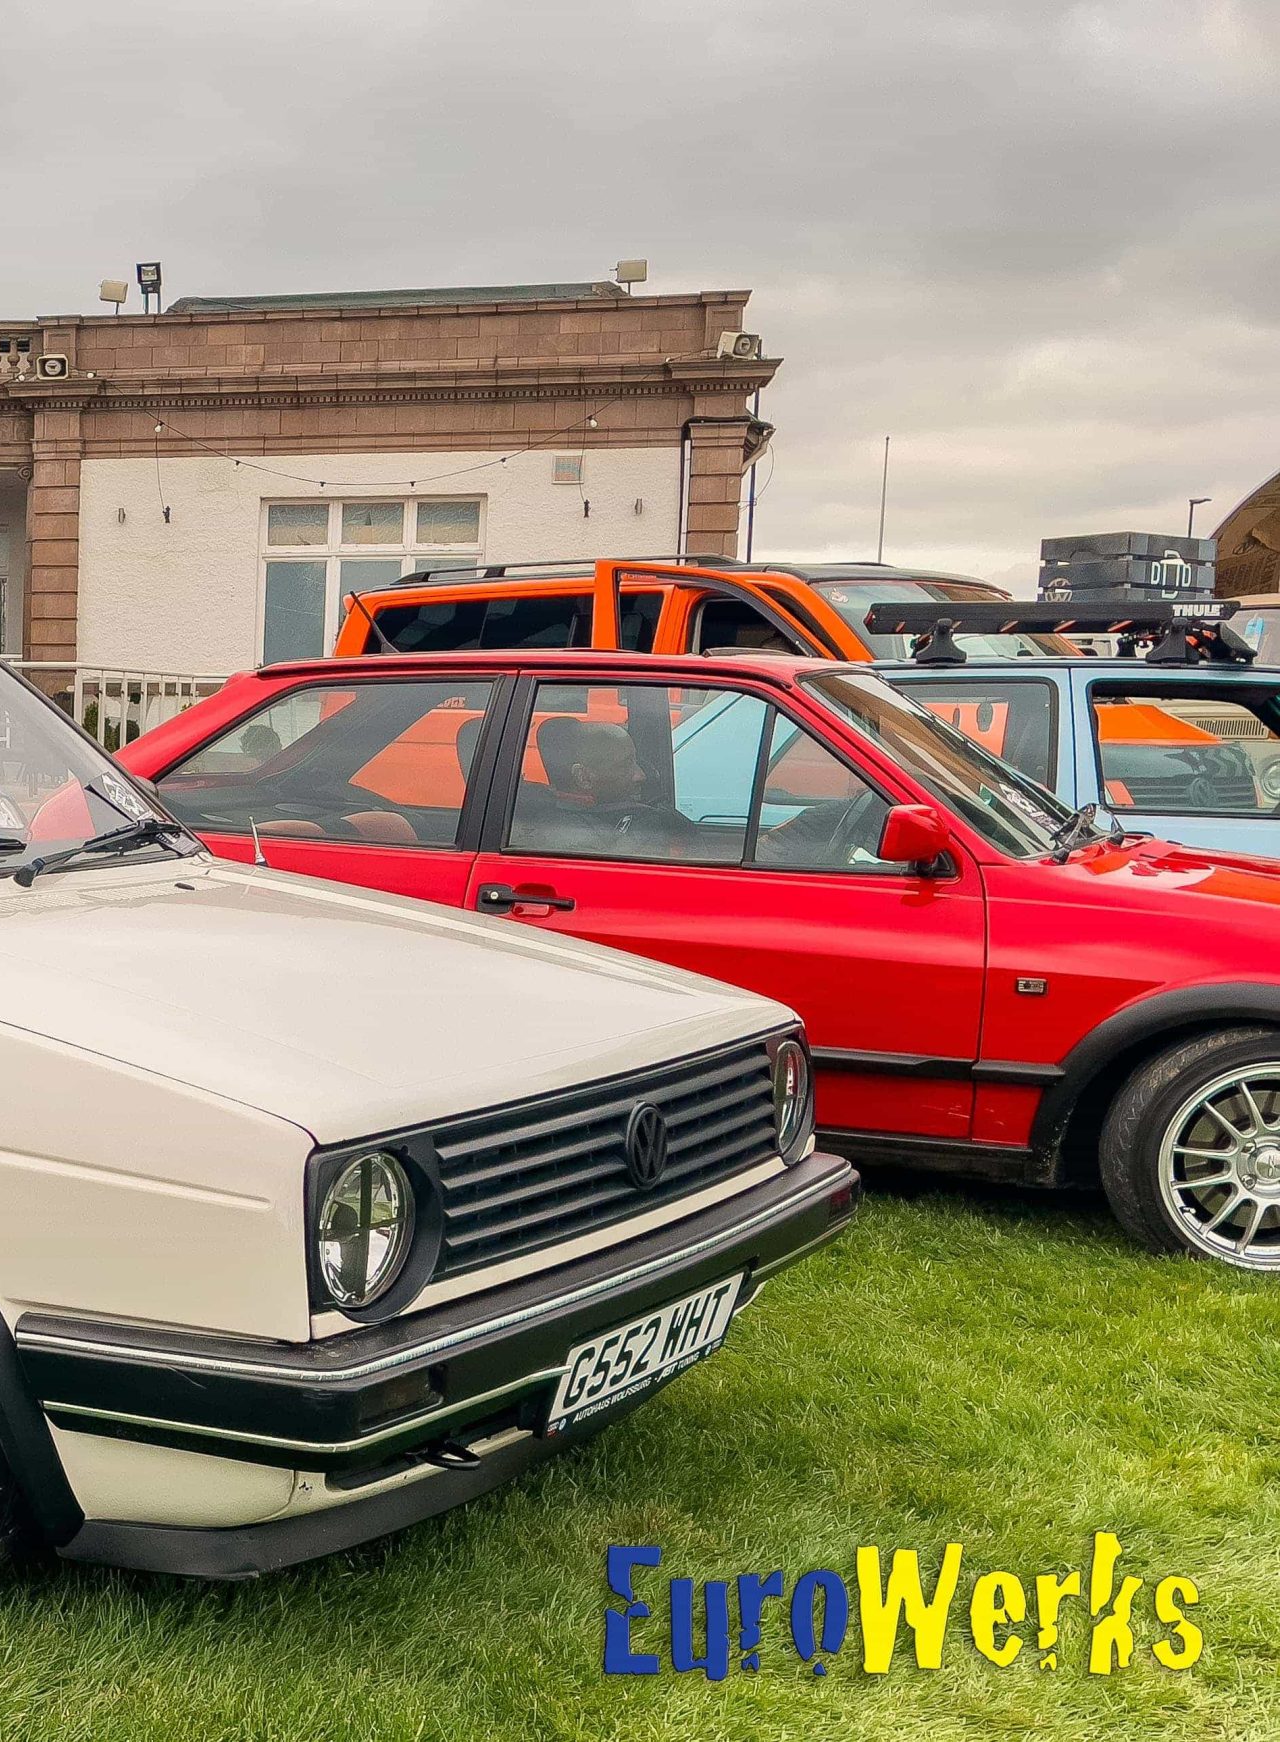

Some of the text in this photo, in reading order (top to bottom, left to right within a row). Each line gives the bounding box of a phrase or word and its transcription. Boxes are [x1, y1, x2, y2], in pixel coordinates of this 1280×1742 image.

[1173, 604, 1221, 617] THULE
[563, 1283, 731, 1409] G552 WHT
[573, 1397, 611, 1424] AUTOHAUS
[611, 1377, 652, 1404] WOLFSBURG
